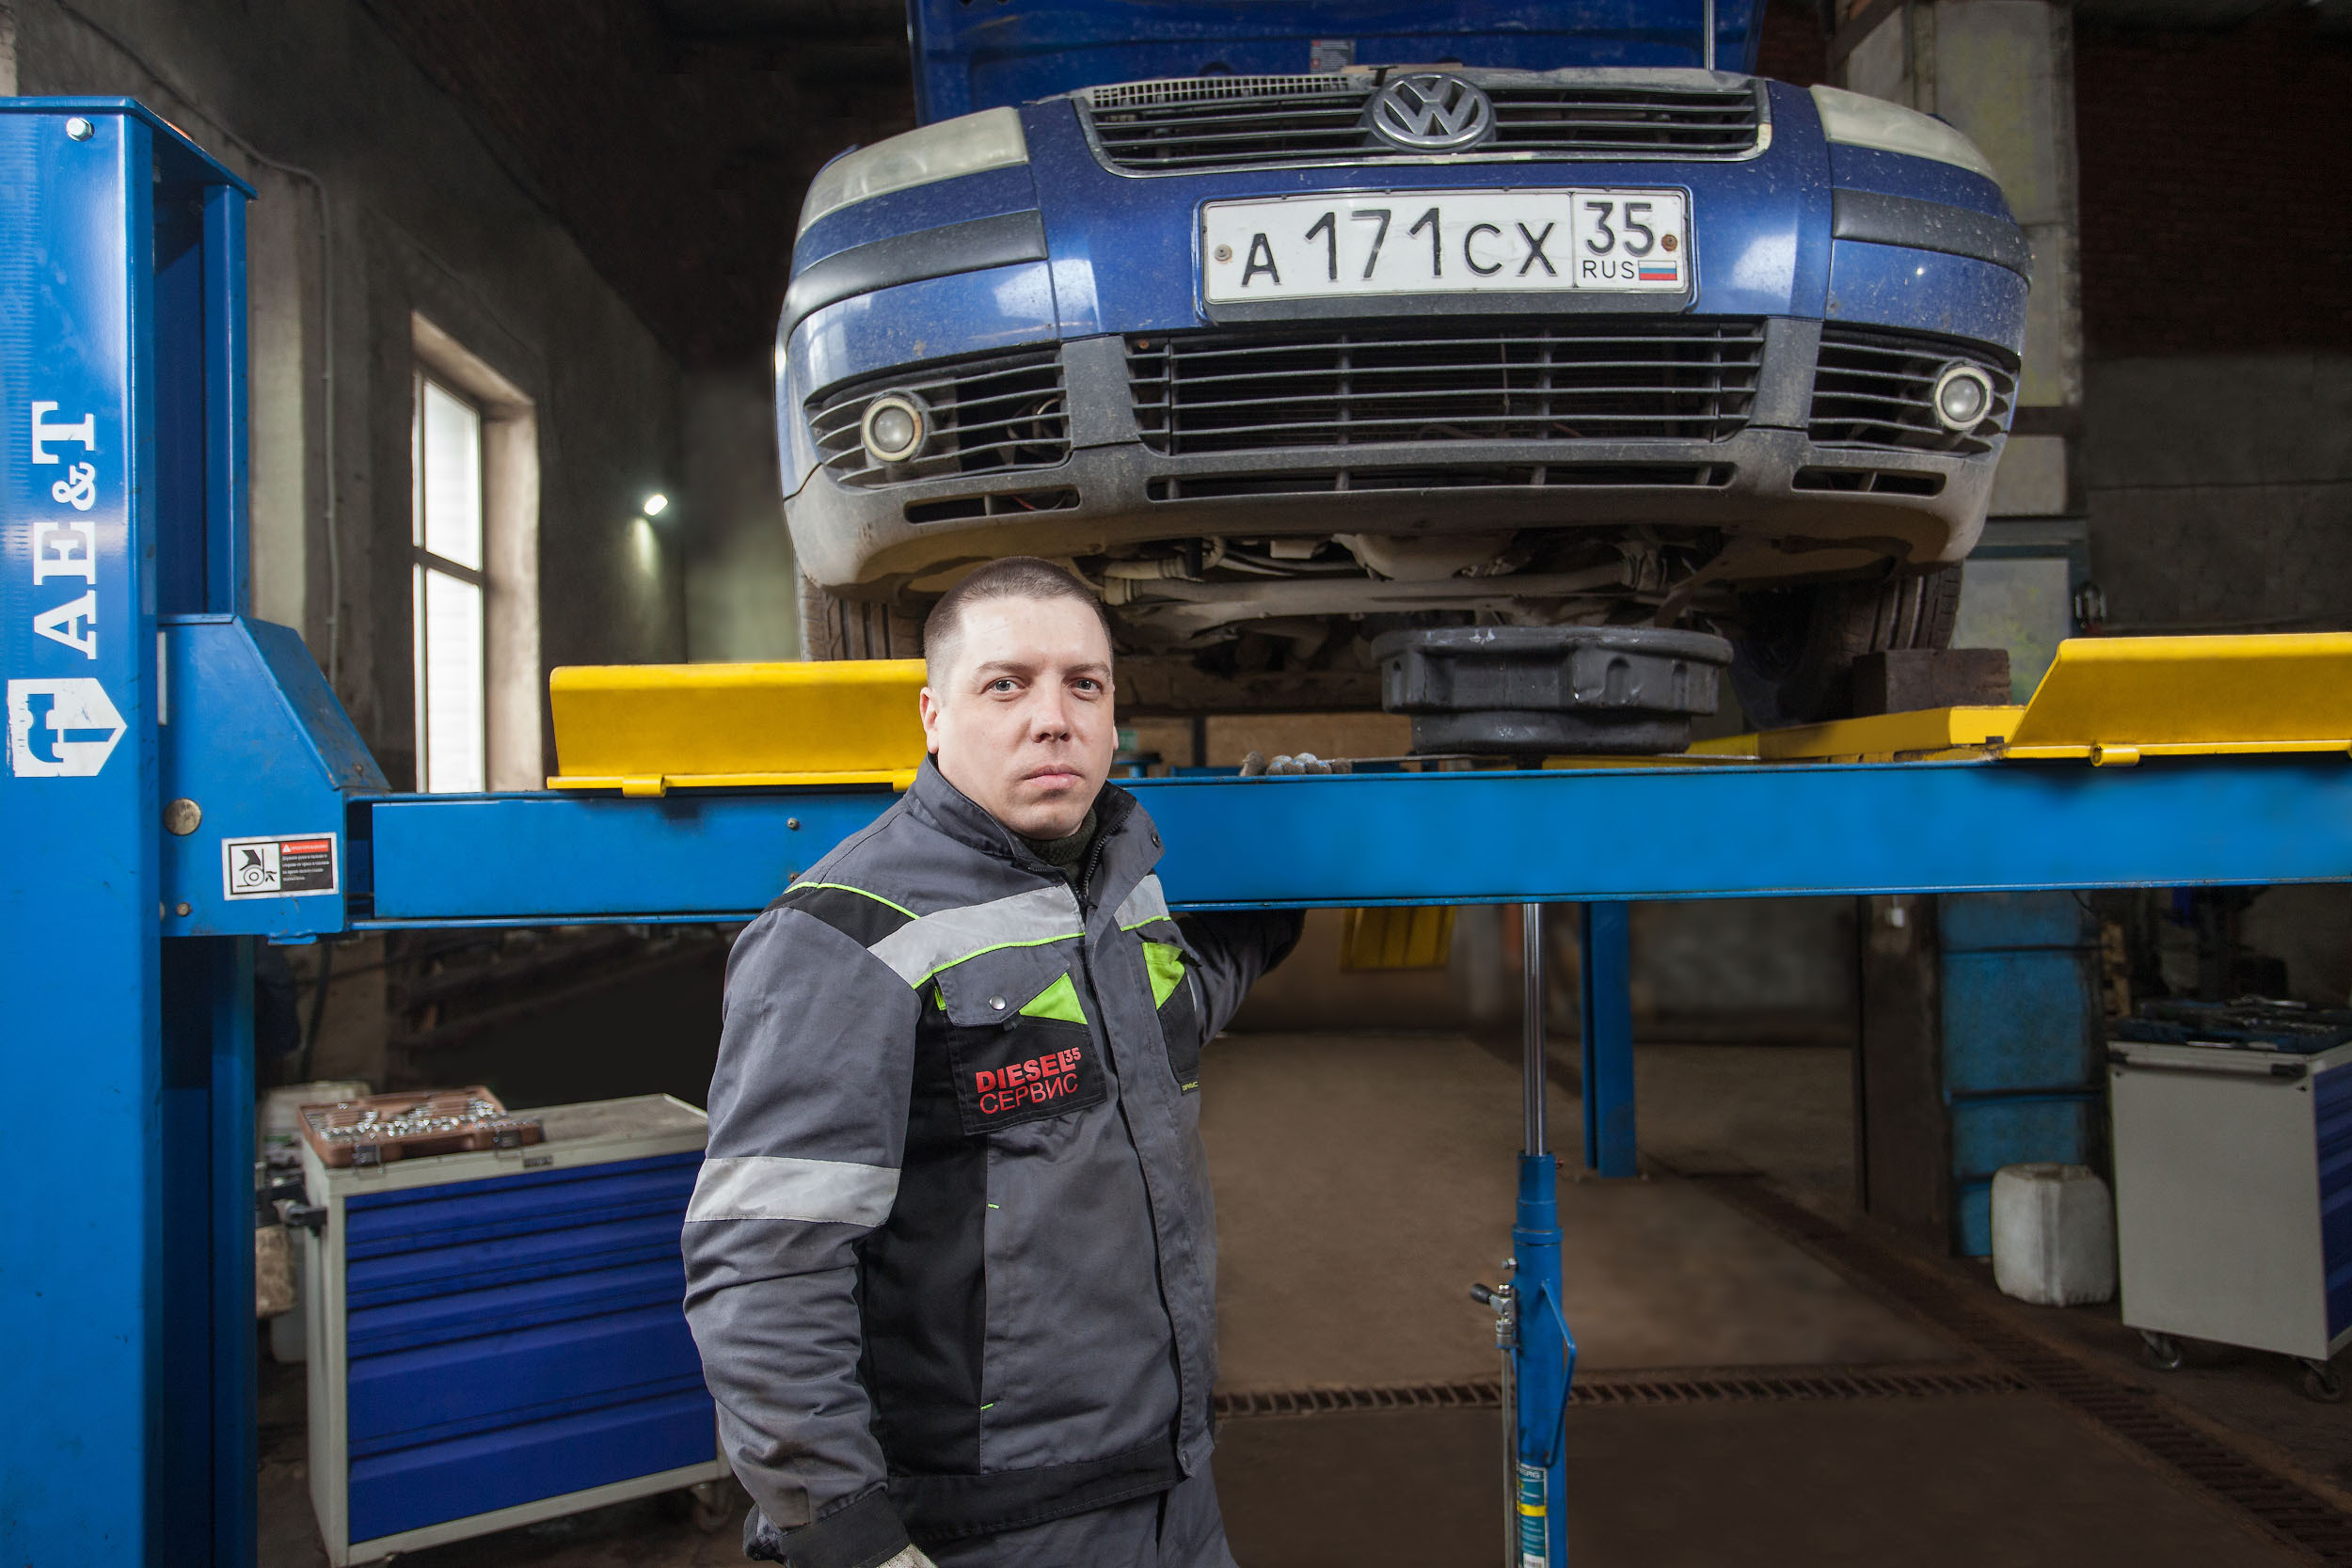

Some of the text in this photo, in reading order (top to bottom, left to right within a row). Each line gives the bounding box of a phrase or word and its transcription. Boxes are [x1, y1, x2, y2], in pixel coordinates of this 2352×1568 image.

[1583, 201, 1655, 257] 35
[1582, 261, 1635, 279] RUS
[976, 1051, 1076, 1093] DIESEL
[979, 1072, 1078, 1115] СЕРВИС
